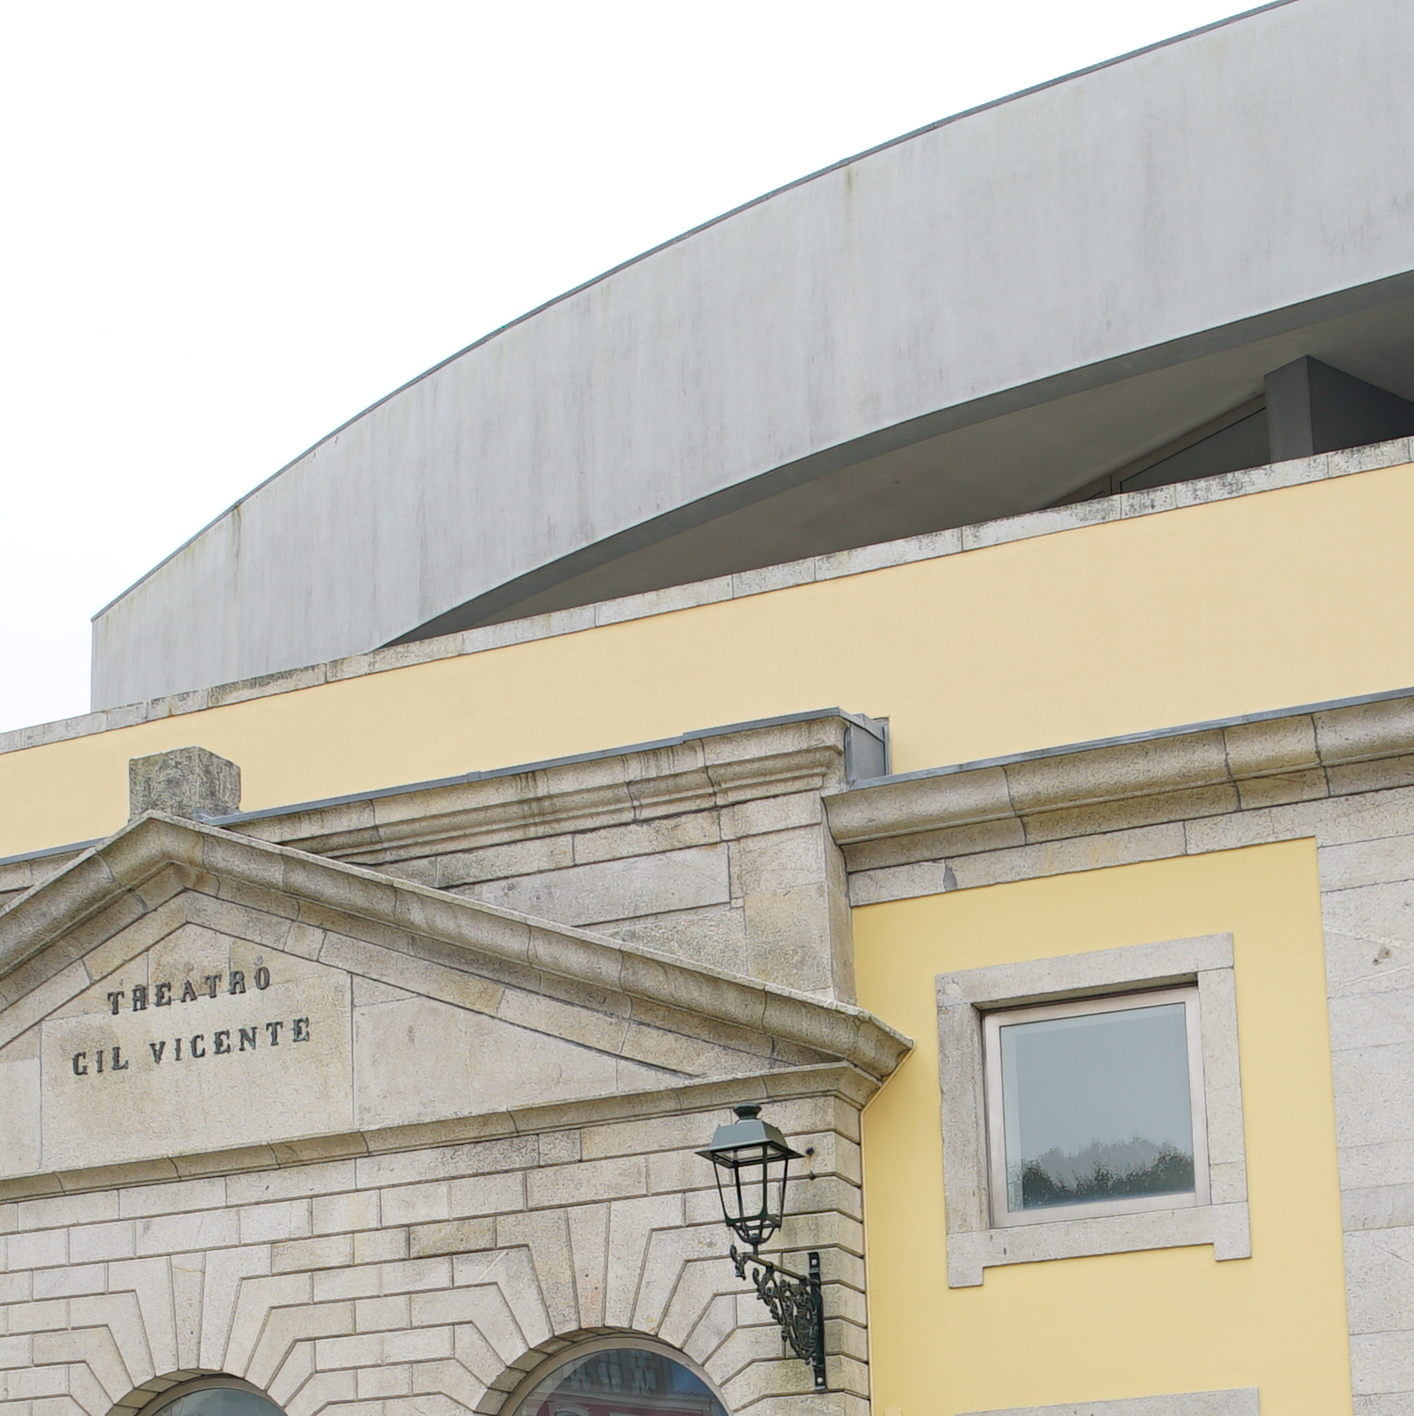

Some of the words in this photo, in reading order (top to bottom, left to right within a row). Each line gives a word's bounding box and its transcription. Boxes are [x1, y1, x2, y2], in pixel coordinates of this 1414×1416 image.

[106, 965, 271, 1015] THEATRO
[72, 1046, 129, 1076] GIL
[149, 1016, 312, 1064] VICENTE
